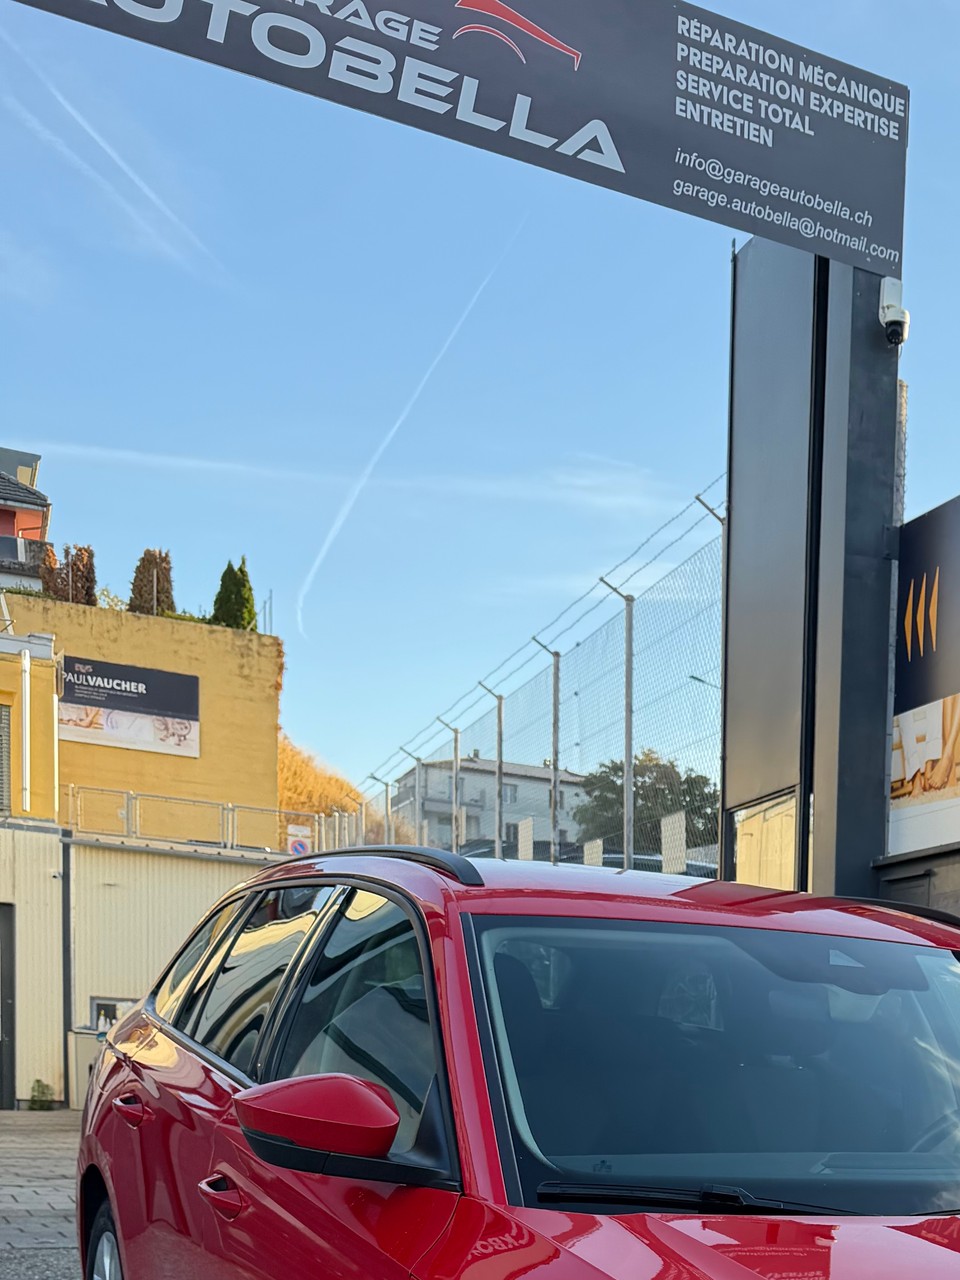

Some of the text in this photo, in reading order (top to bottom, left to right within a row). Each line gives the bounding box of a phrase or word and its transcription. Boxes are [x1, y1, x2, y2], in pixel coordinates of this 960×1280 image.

[676, 42, 899, 140] PREPARATION EXPERTISE
[676, 69, 815, 136] SERVICE TOTAL
[677, 15, 905, 117] RÉPARATION MÉCANIQUE
[675, 96, 773, 147] ENTRETIEN
[672, 179, 899, 263] garage.autobella@hotmail.com
[674, 148, 873, 227] info@garageautobella.ch
